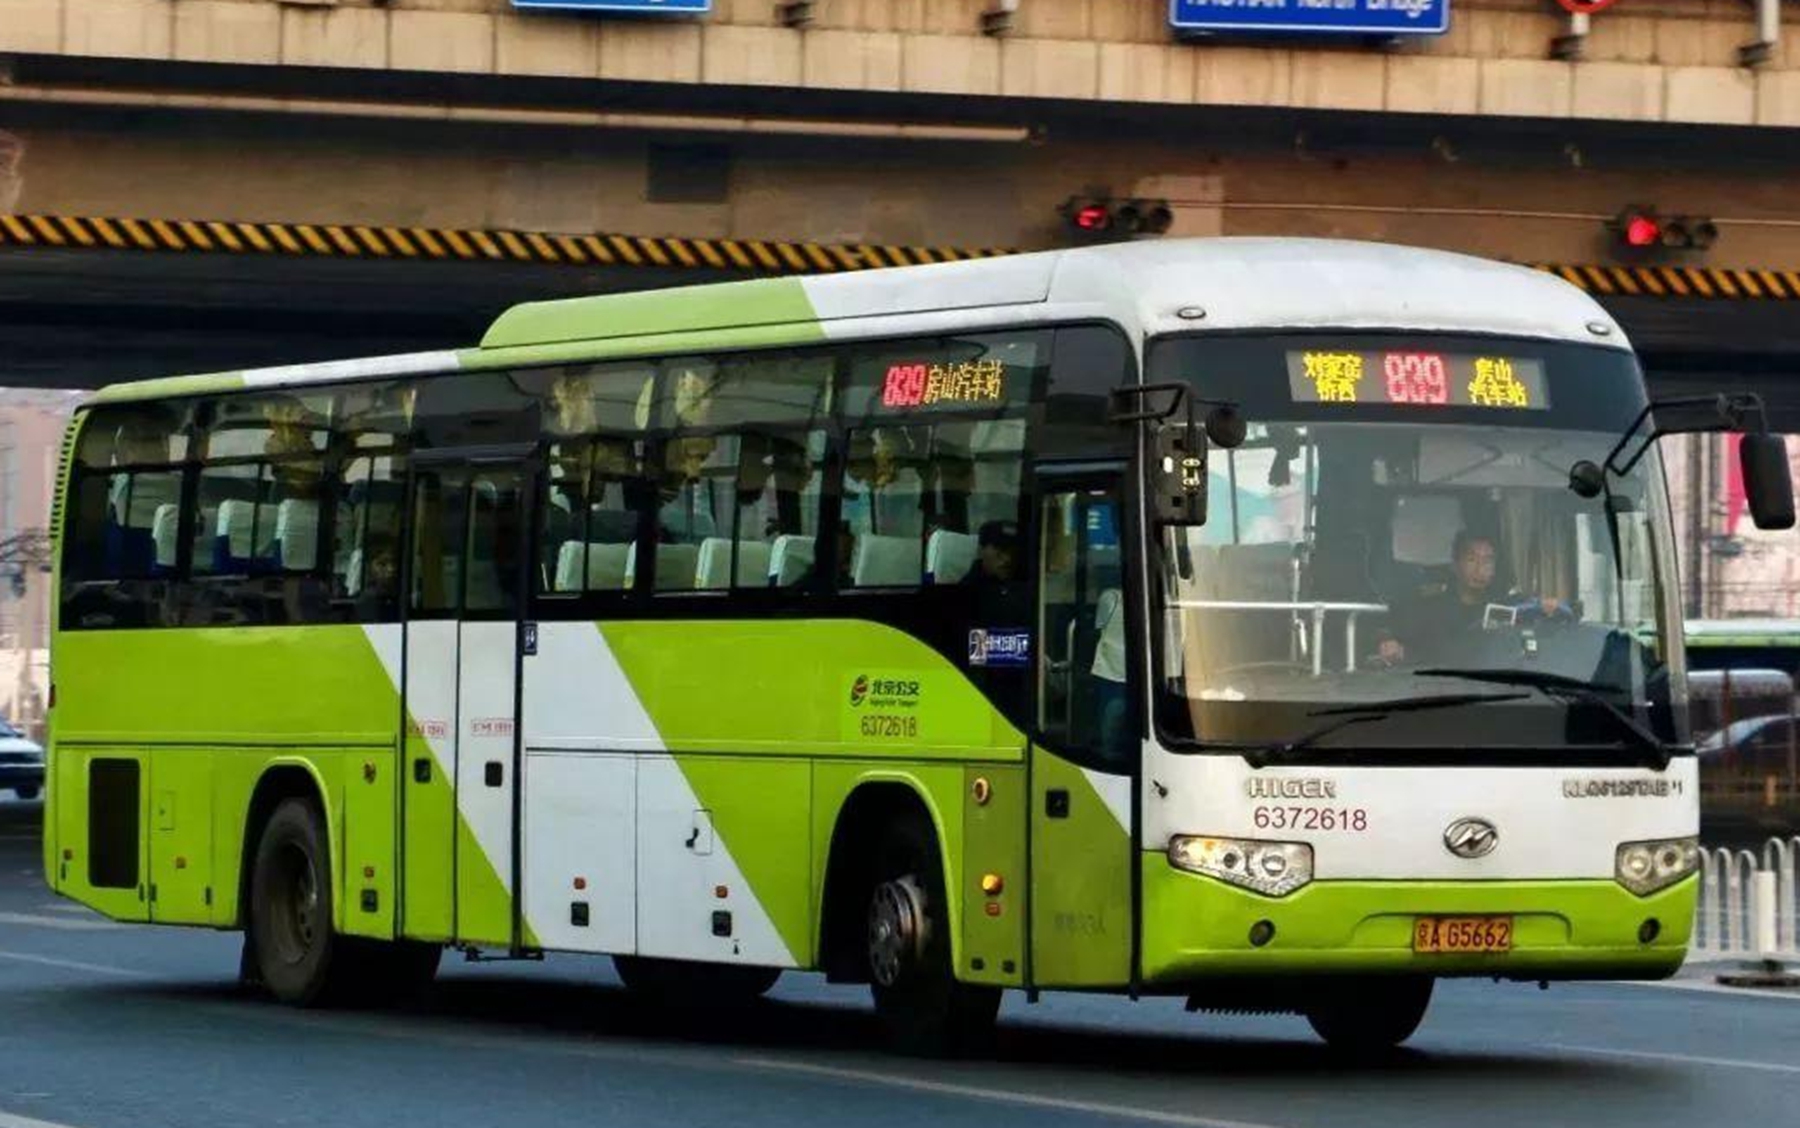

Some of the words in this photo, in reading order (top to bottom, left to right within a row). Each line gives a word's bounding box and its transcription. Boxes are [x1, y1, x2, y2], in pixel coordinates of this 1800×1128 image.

[883, 365, 926, 406] 839
[1384, 353, 1448, 404] 839
[872, 680, 919, 696] 北京公交
[861, 715, 917, 737] 6372618
[1248, 777, 1336, 799] HIGER
[1254, 806, 1368, 831] 6372618
